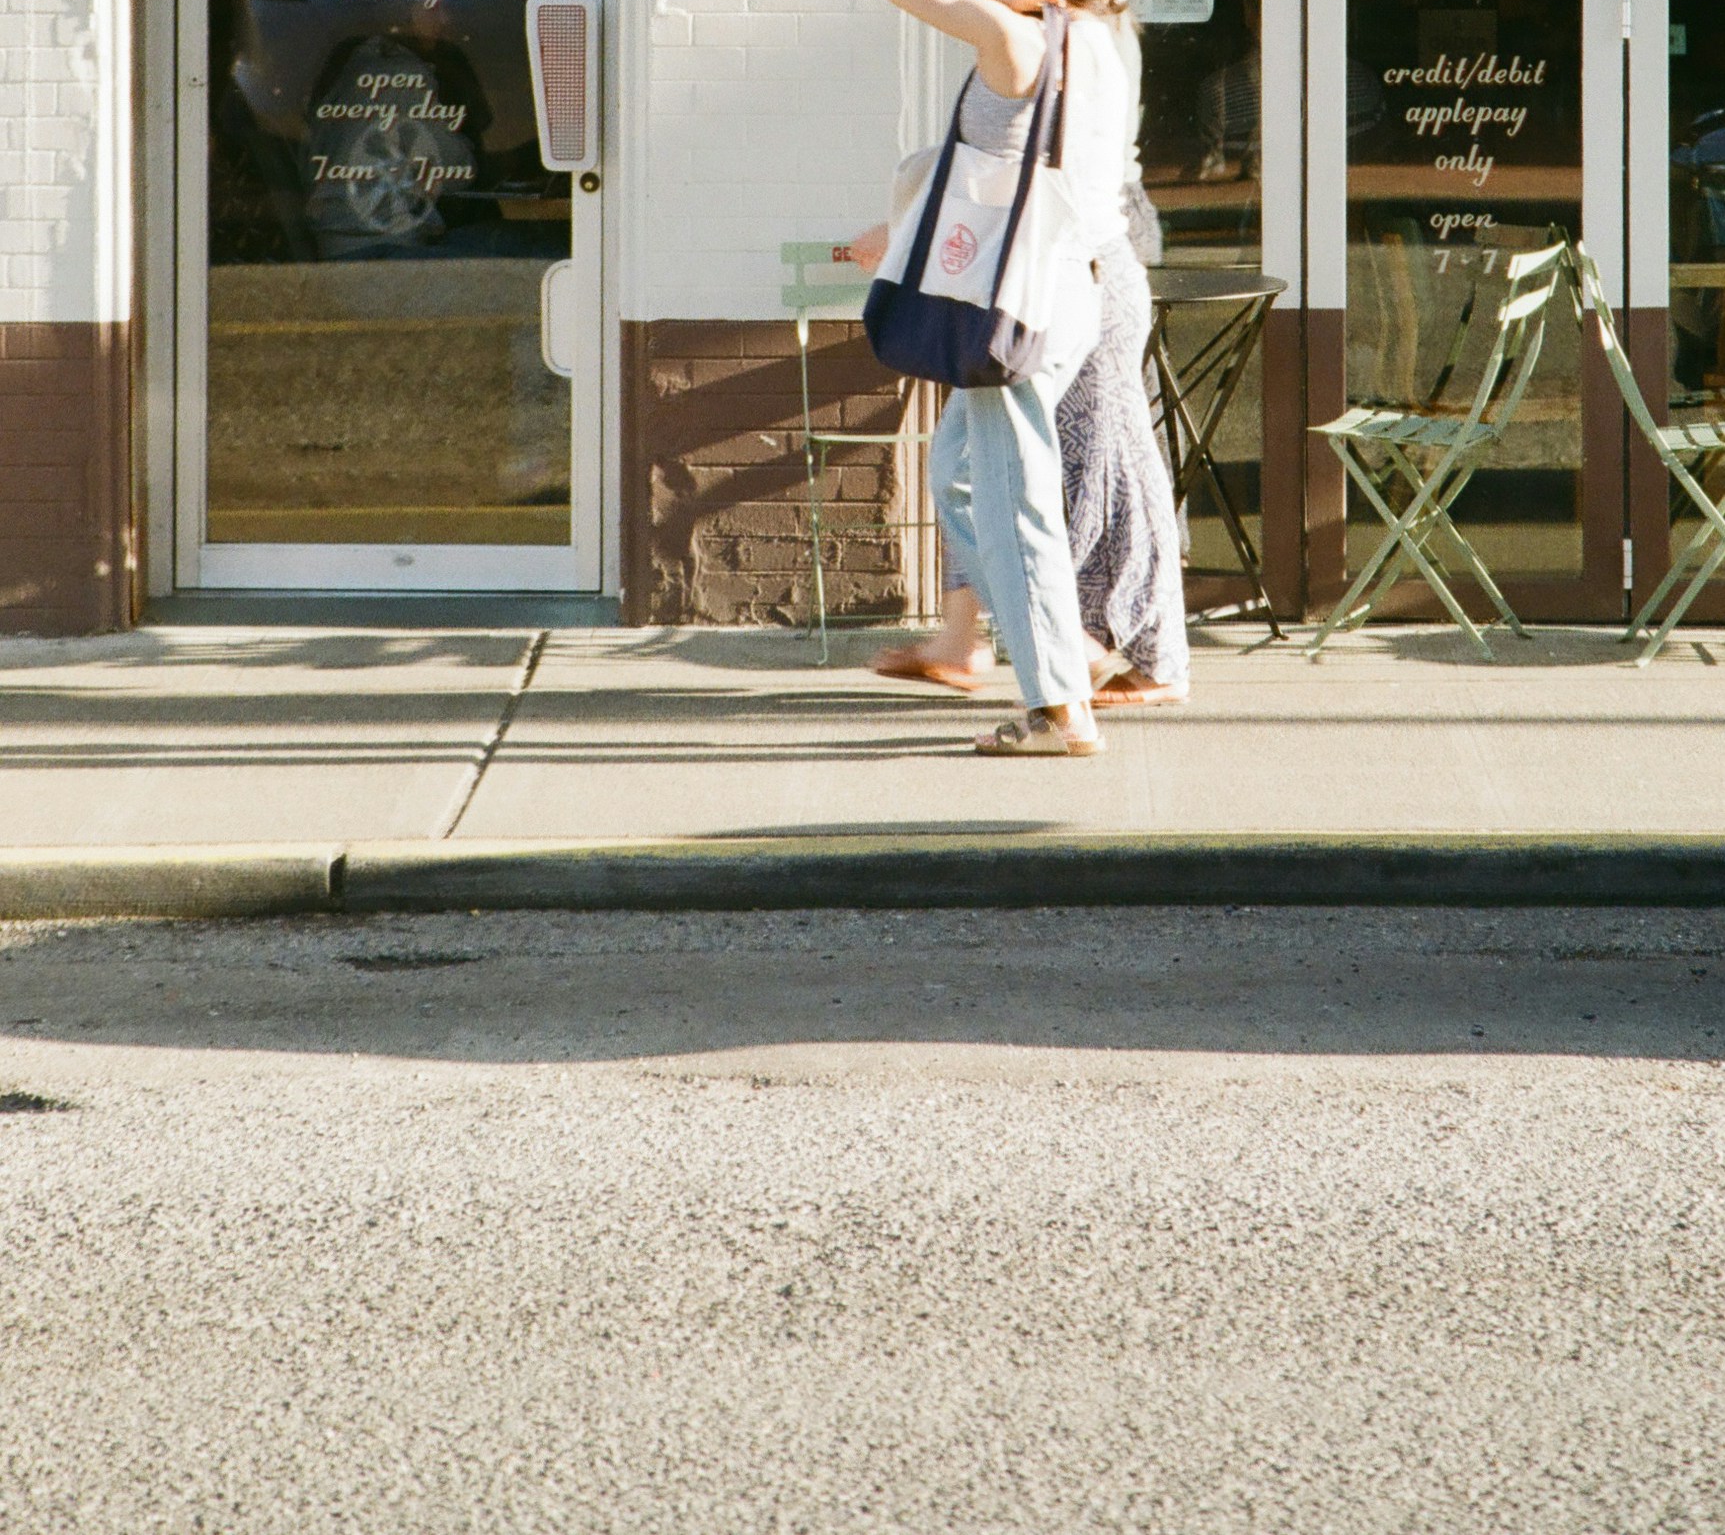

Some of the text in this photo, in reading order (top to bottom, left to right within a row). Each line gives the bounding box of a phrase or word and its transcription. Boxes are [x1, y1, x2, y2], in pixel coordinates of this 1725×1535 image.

[356, 73, 428, 100] open
[1383, 52, 1547, 90] credit/debit
[316, 89, 467, 132] every day
[1405, 97, 1528, 138] applepay
[311, 155, 376, 182] 7am
[412, 156, 475, 192] 7pm
[1434, 143, 1495, 188] only
[1430, 212, 1498, 241] open
[1433, 249, 1452, 275] 7
[1482, 249, 1499, 275] 7
